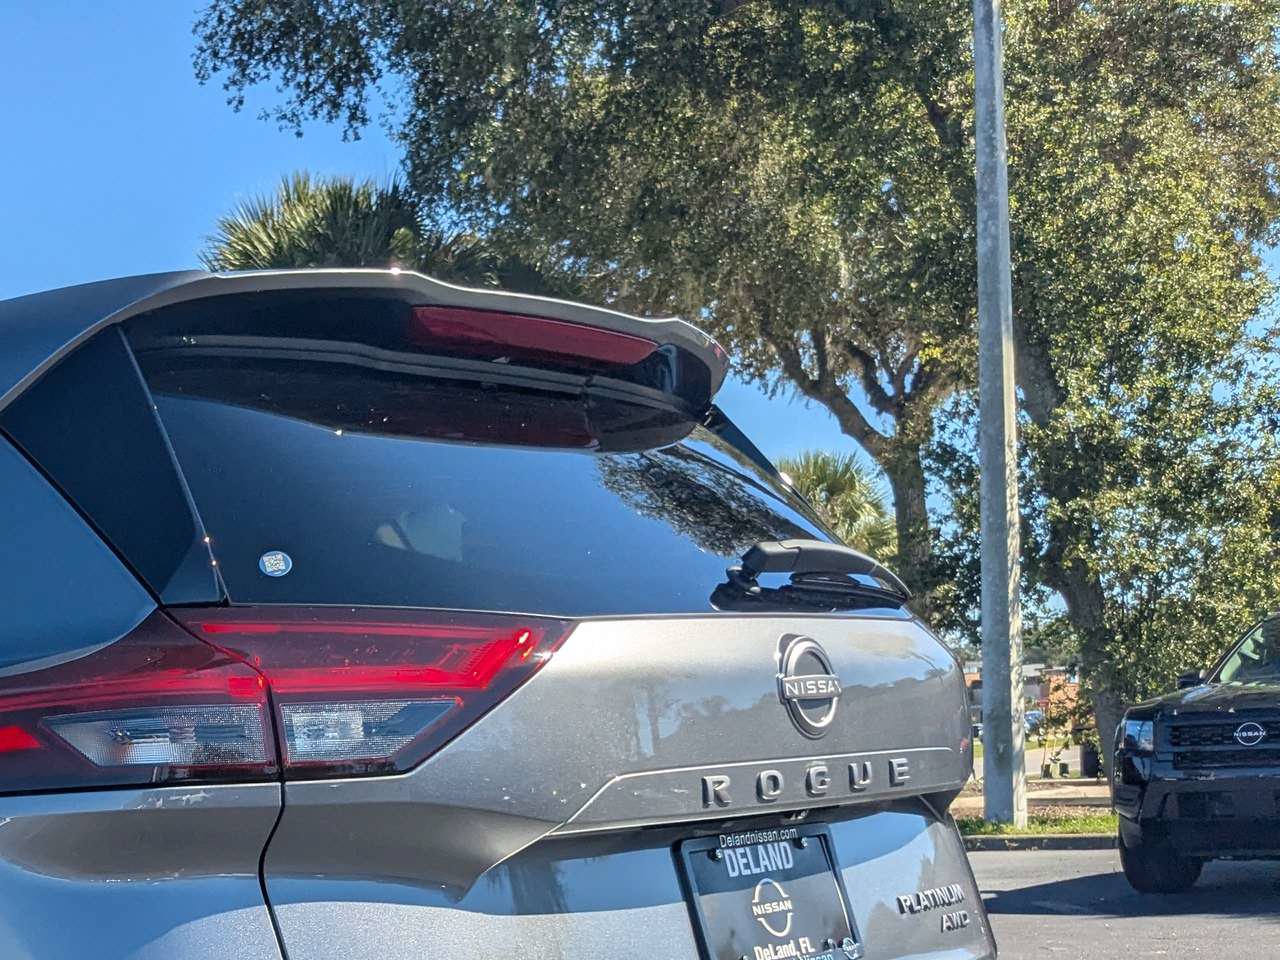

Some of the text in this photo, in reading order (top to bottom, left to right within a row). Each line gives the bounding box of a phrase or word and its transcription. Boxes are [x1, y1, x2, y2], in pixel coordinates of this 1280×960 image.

[702, 757, 912, 808] ROGUE
[719, 828, 798, 848] Delandnissan.com
[723, 841, 794, 878] DELAND
[752, 899, 793, 916] NISSAN
[897, 883, 965, 914] PLATINUM
[941, 910, 970, 933] AWD
[798, 936, 816, 954] FL
